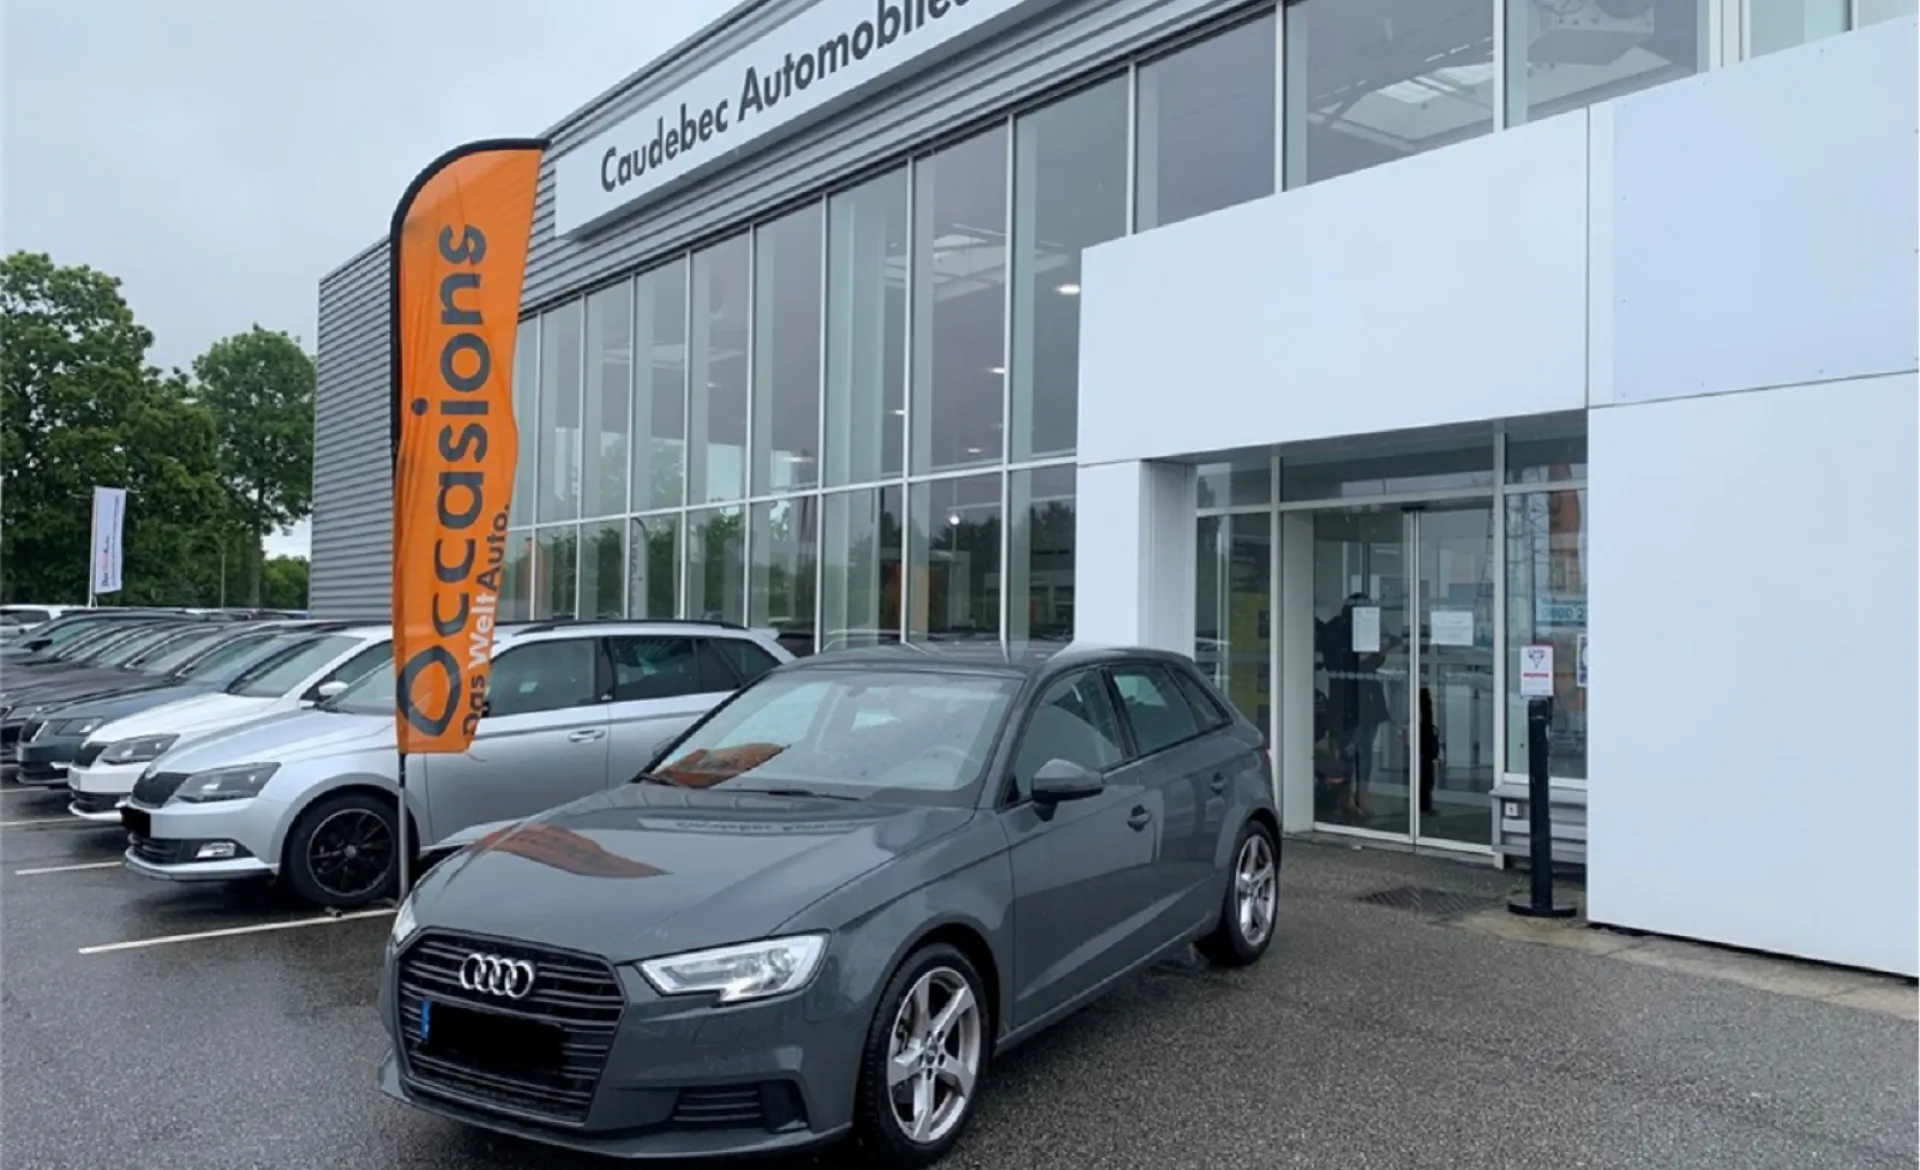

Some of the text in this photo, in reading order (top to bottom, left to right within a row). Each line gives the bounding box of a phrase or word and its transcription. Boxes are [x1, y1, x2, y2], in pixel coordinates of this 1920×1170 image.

[600, 0, 971, 193] Caudebec Automobi
[396, 224, 489, 737] Occasions
